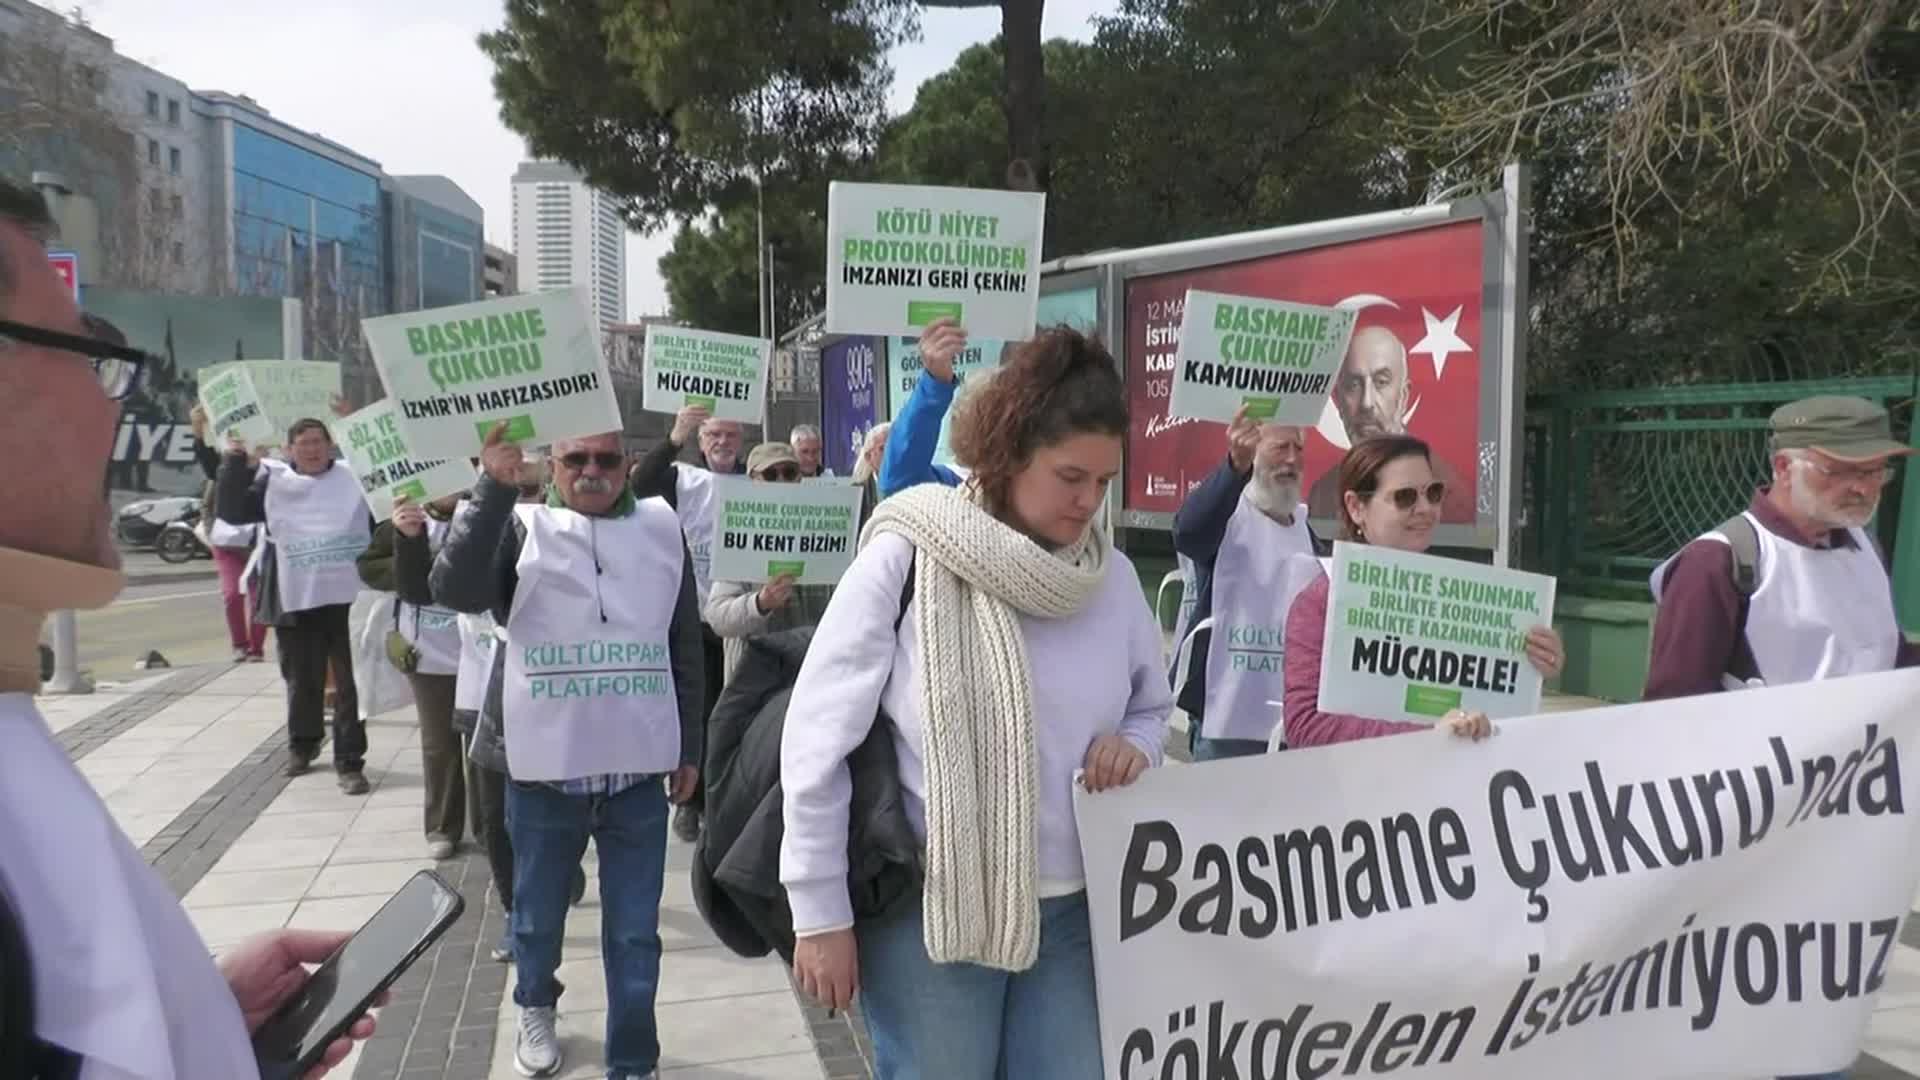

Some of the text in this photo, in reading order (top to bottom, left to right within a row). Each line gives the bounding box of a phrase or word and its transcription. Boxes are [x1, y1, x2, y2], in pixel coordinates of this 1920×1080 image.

[877, 207, 998, 238] KÖTÜ NİYET
[844, 238, 1027, 269] PROTOKOLÜNDEN
[843, 265, 1026, 294] İMZANIZI GERİ ÇEKİN!
[1147, 301, 1160, 320] 12
[1215, 302, 1329, 342] BASMANE
[406, 307, 547, 356] BASMANE
[654, 335, 697, 350] BİRLİKTE
[428, 342, 543, 393] ÇUKURU
[1220, 335, 1315, 368] ÇUKURU
[657, 369, 750, 401] MÜCADELE!
[1146, 380, 1168, 398] 105
[1184, 360, 1332, 395] KAMUNUNDUR!
[401, 372, 599, 419] İZMİR'İN HAFIZASIDIR!
[724, 499, 778, 516] BASMANE
[727, 515, 758, 529] BUCA
[760, 517, 801, 531] CEZAEVİ
[724, 531, 847, 553] BU KENT BİZİM!
[1348, 560, 1540, 615] BİRLİKTE SAVUNMAK,
[1370, 590, 1517, 632] BİRLİKTE KORUMAK,
[1347, 607, 1414, 635] BİRLİKTE
[1419, 619, 1501, 649] KAZANMAK
[1352, 635, 1519, 695] MÜCADELE!
[531, 674, 668, 699] PLATFORMU
[1120, 723, 1904, 942] Basmane Çukuru'nda
[1484, 912, 1899, 1056] İstemiyoruz
